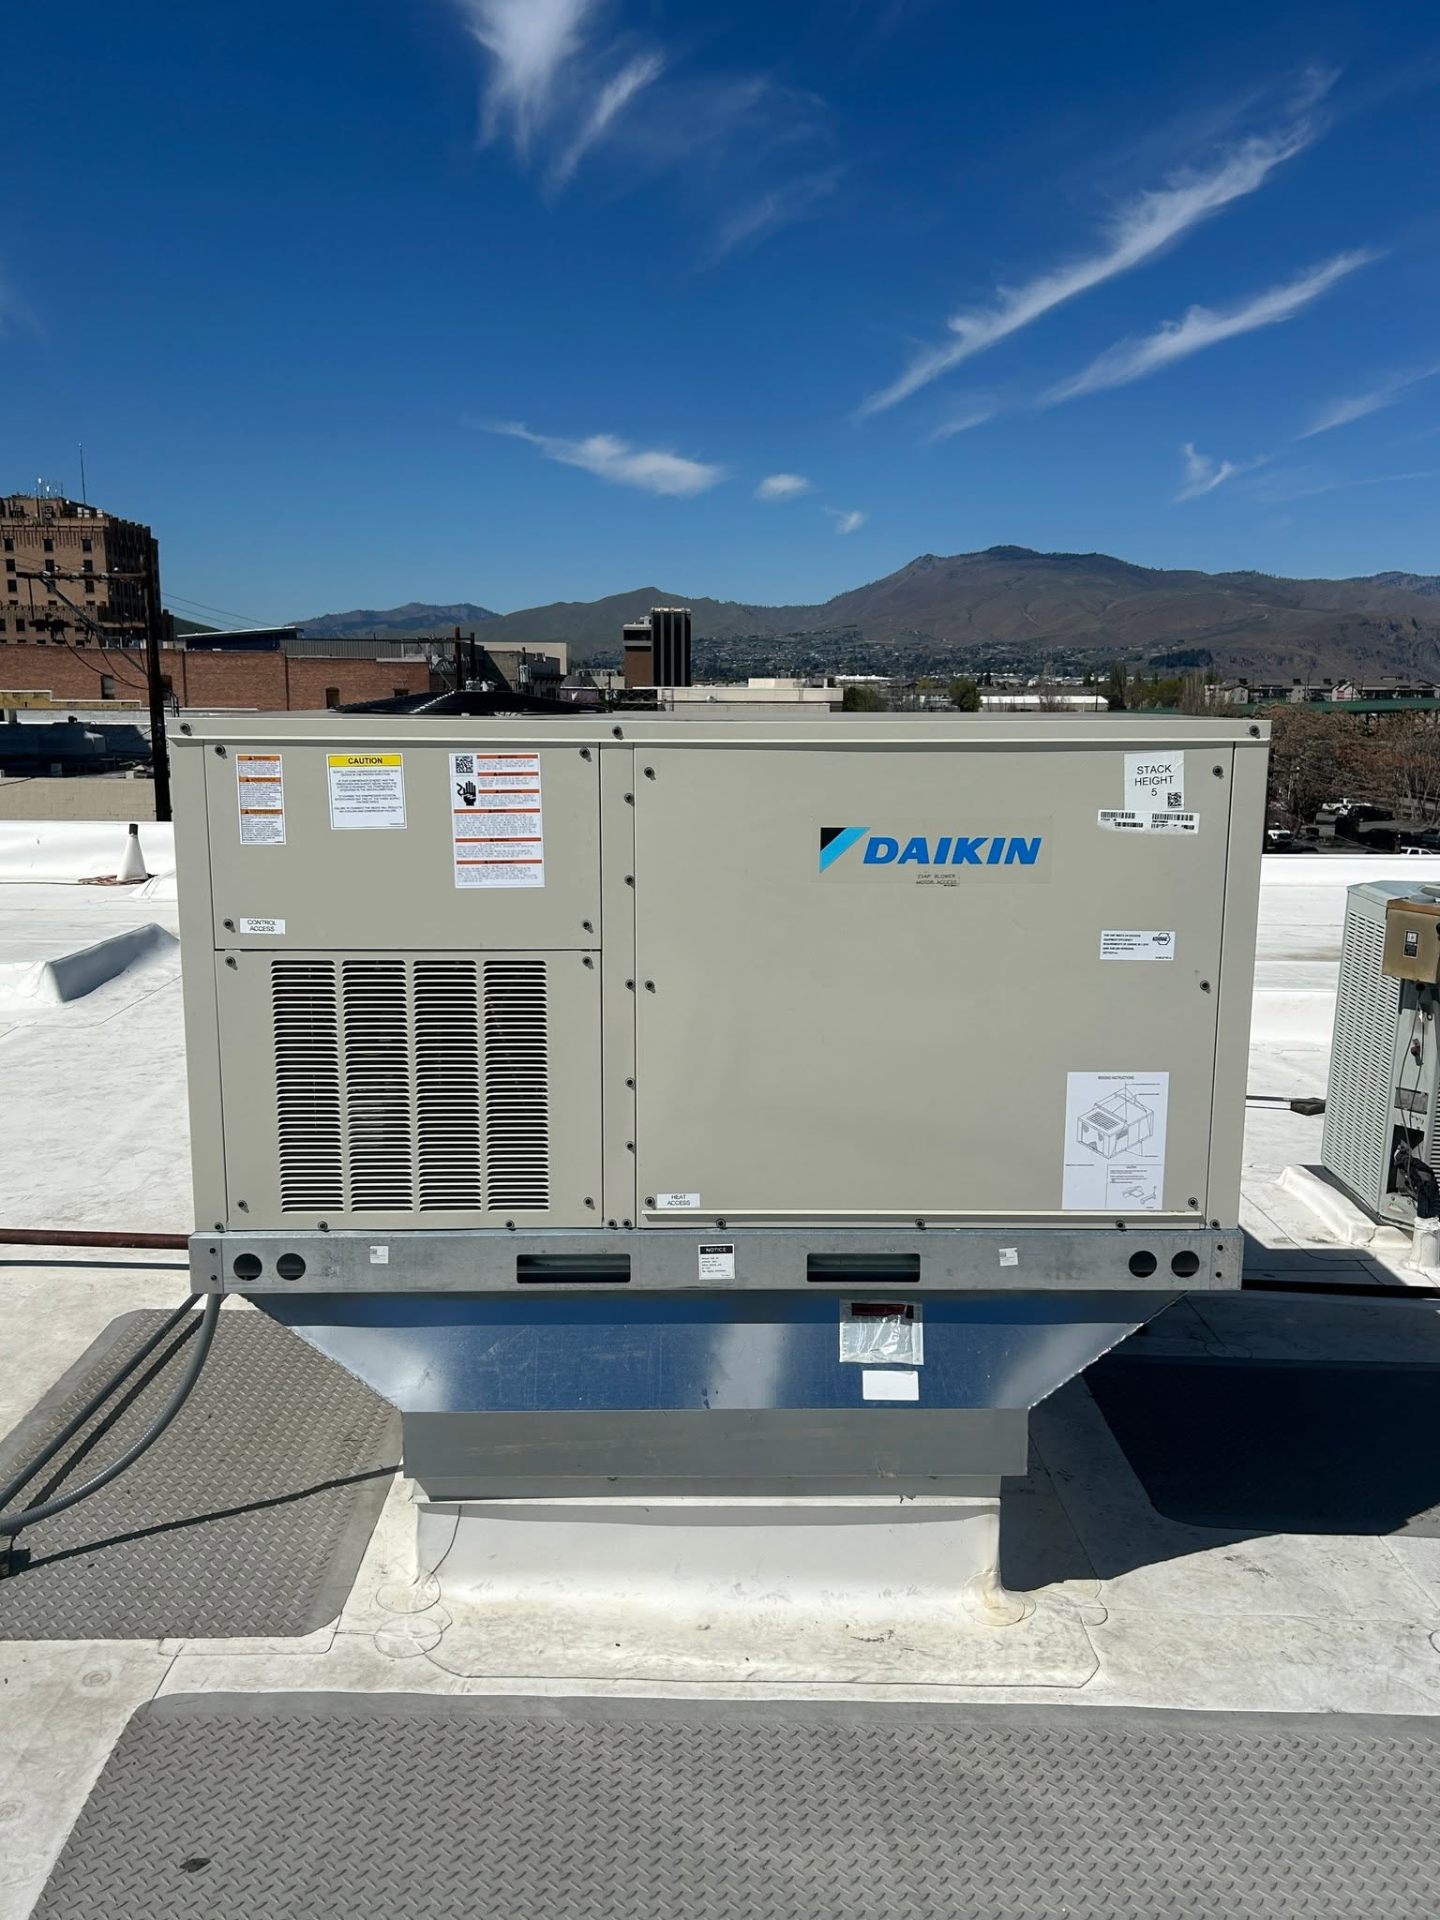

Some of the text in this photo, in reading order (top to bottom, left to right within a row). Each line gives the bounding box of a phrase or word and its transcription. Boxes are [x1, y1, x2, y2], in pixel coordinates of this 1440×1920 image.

[1136, 764, 1172, 775] STACK
[1134, 775, 1174, 786] HEIGHT
[1151, 787, 1158, 796] 5
[863, 837, 1042, 864] DAIKIN
